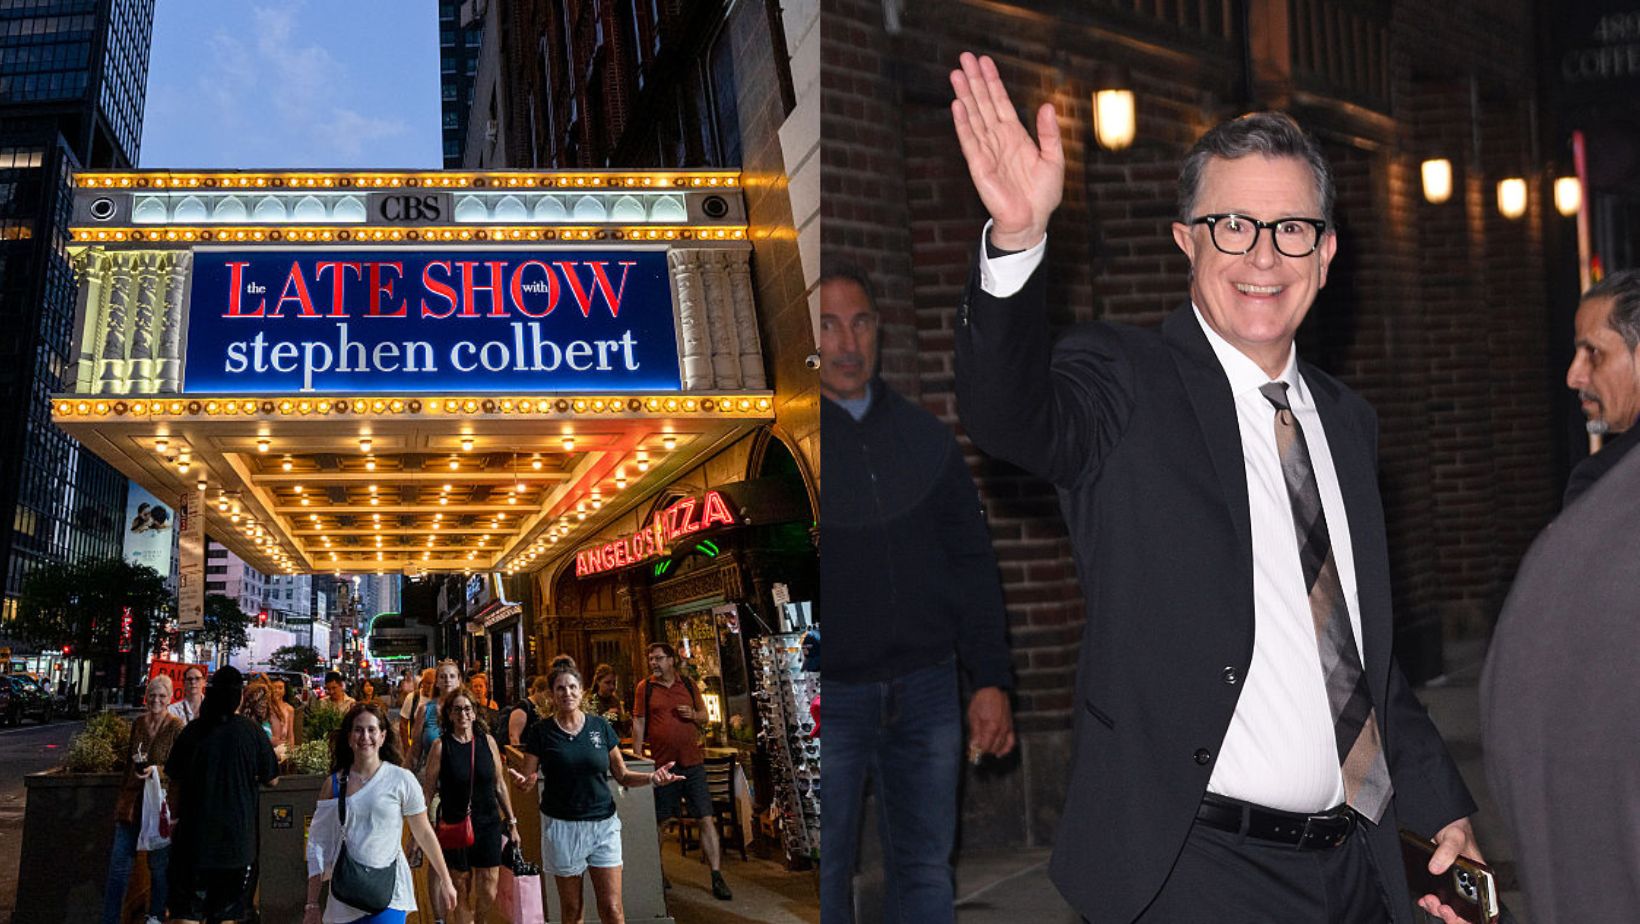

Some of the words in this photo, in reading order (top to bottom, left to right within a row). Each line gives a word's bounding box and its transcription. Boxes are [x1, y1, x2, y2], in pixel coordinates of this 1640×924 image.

[380, 195, 441, 222] CBS
[221, 260, 408, 319] LATE
[420, 260, 637, 319] SHOW
[246, 281, 266, 294] the
[522, 280, 549, 294] with
[224, 322, 438, 392] stephen
[450, 321, 640, 373] colbert
[575, 528, 655, 577] ANGELO'S
